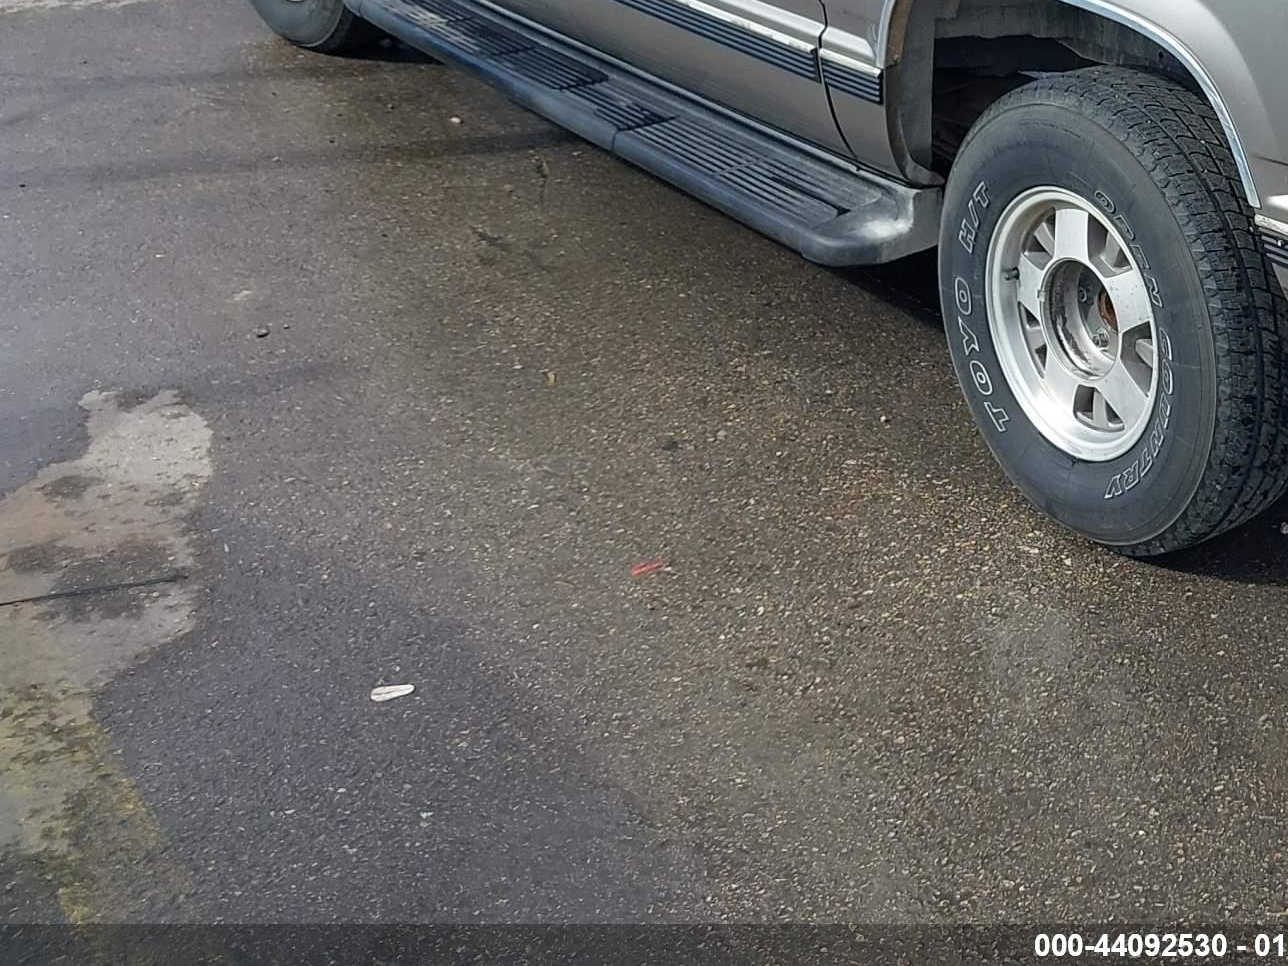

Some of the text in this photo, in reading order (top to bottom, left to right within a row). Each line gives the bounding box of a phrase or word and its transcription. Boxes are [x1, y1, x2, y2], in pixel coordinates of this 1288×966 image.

[954, 181, 1010, 433] TOYO H/T
[1094, 190, 1174, 499] OPEN COUNTRY
